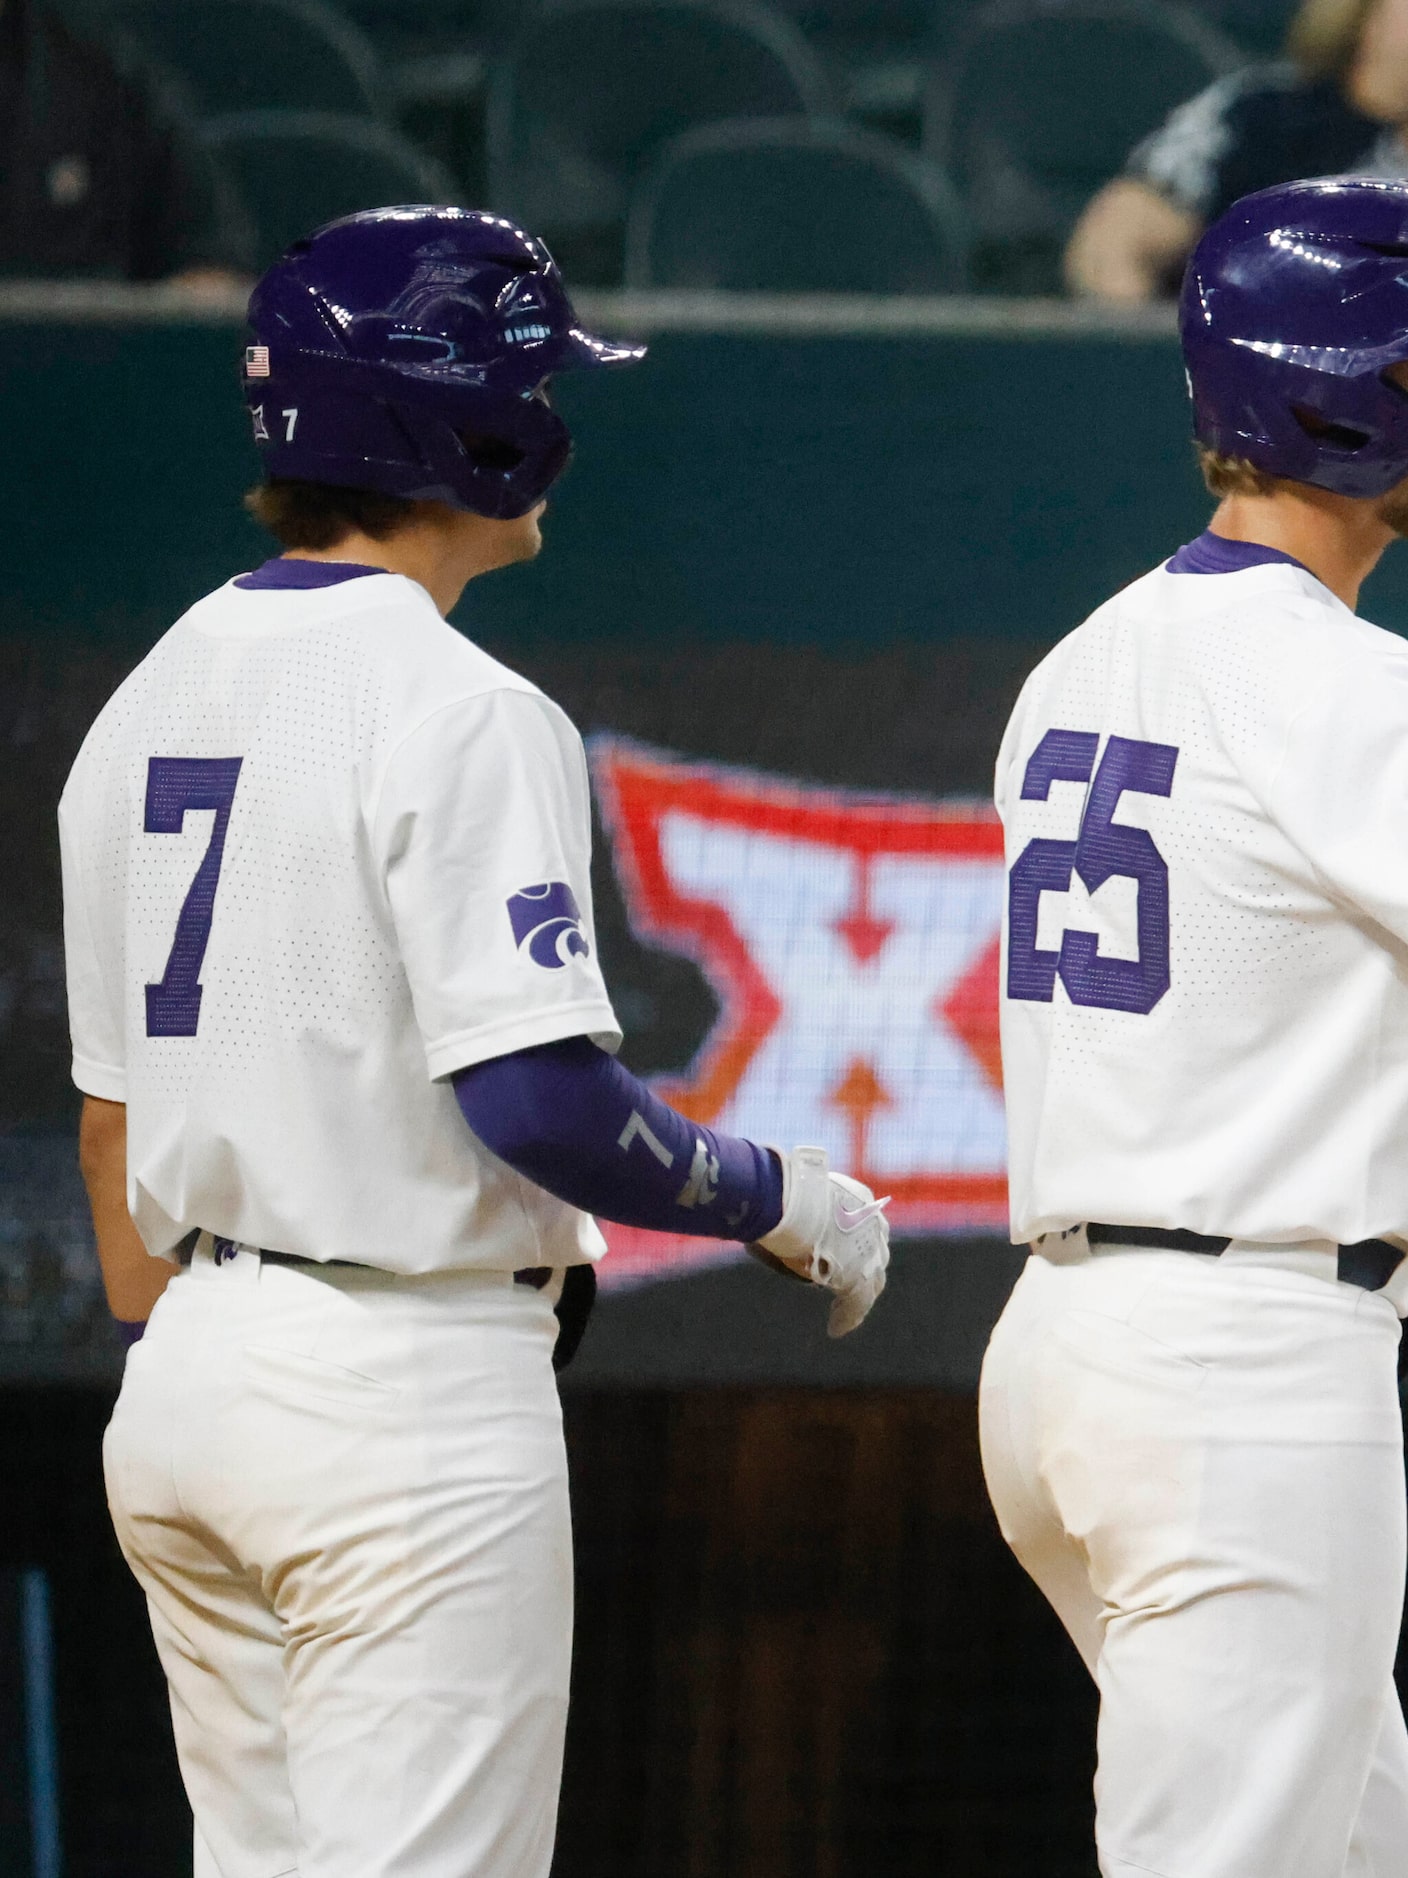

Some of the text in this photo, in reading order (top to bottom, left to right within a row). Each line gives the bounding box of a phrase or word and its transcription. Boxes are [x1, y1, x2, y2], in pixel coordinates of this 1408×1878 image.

[282, 408, 298, 441] 7
[144, 756, 243, 1037] 7
[1007, 728, 1180, 1015] 25
[617, 1109, 674, 1170] 7
